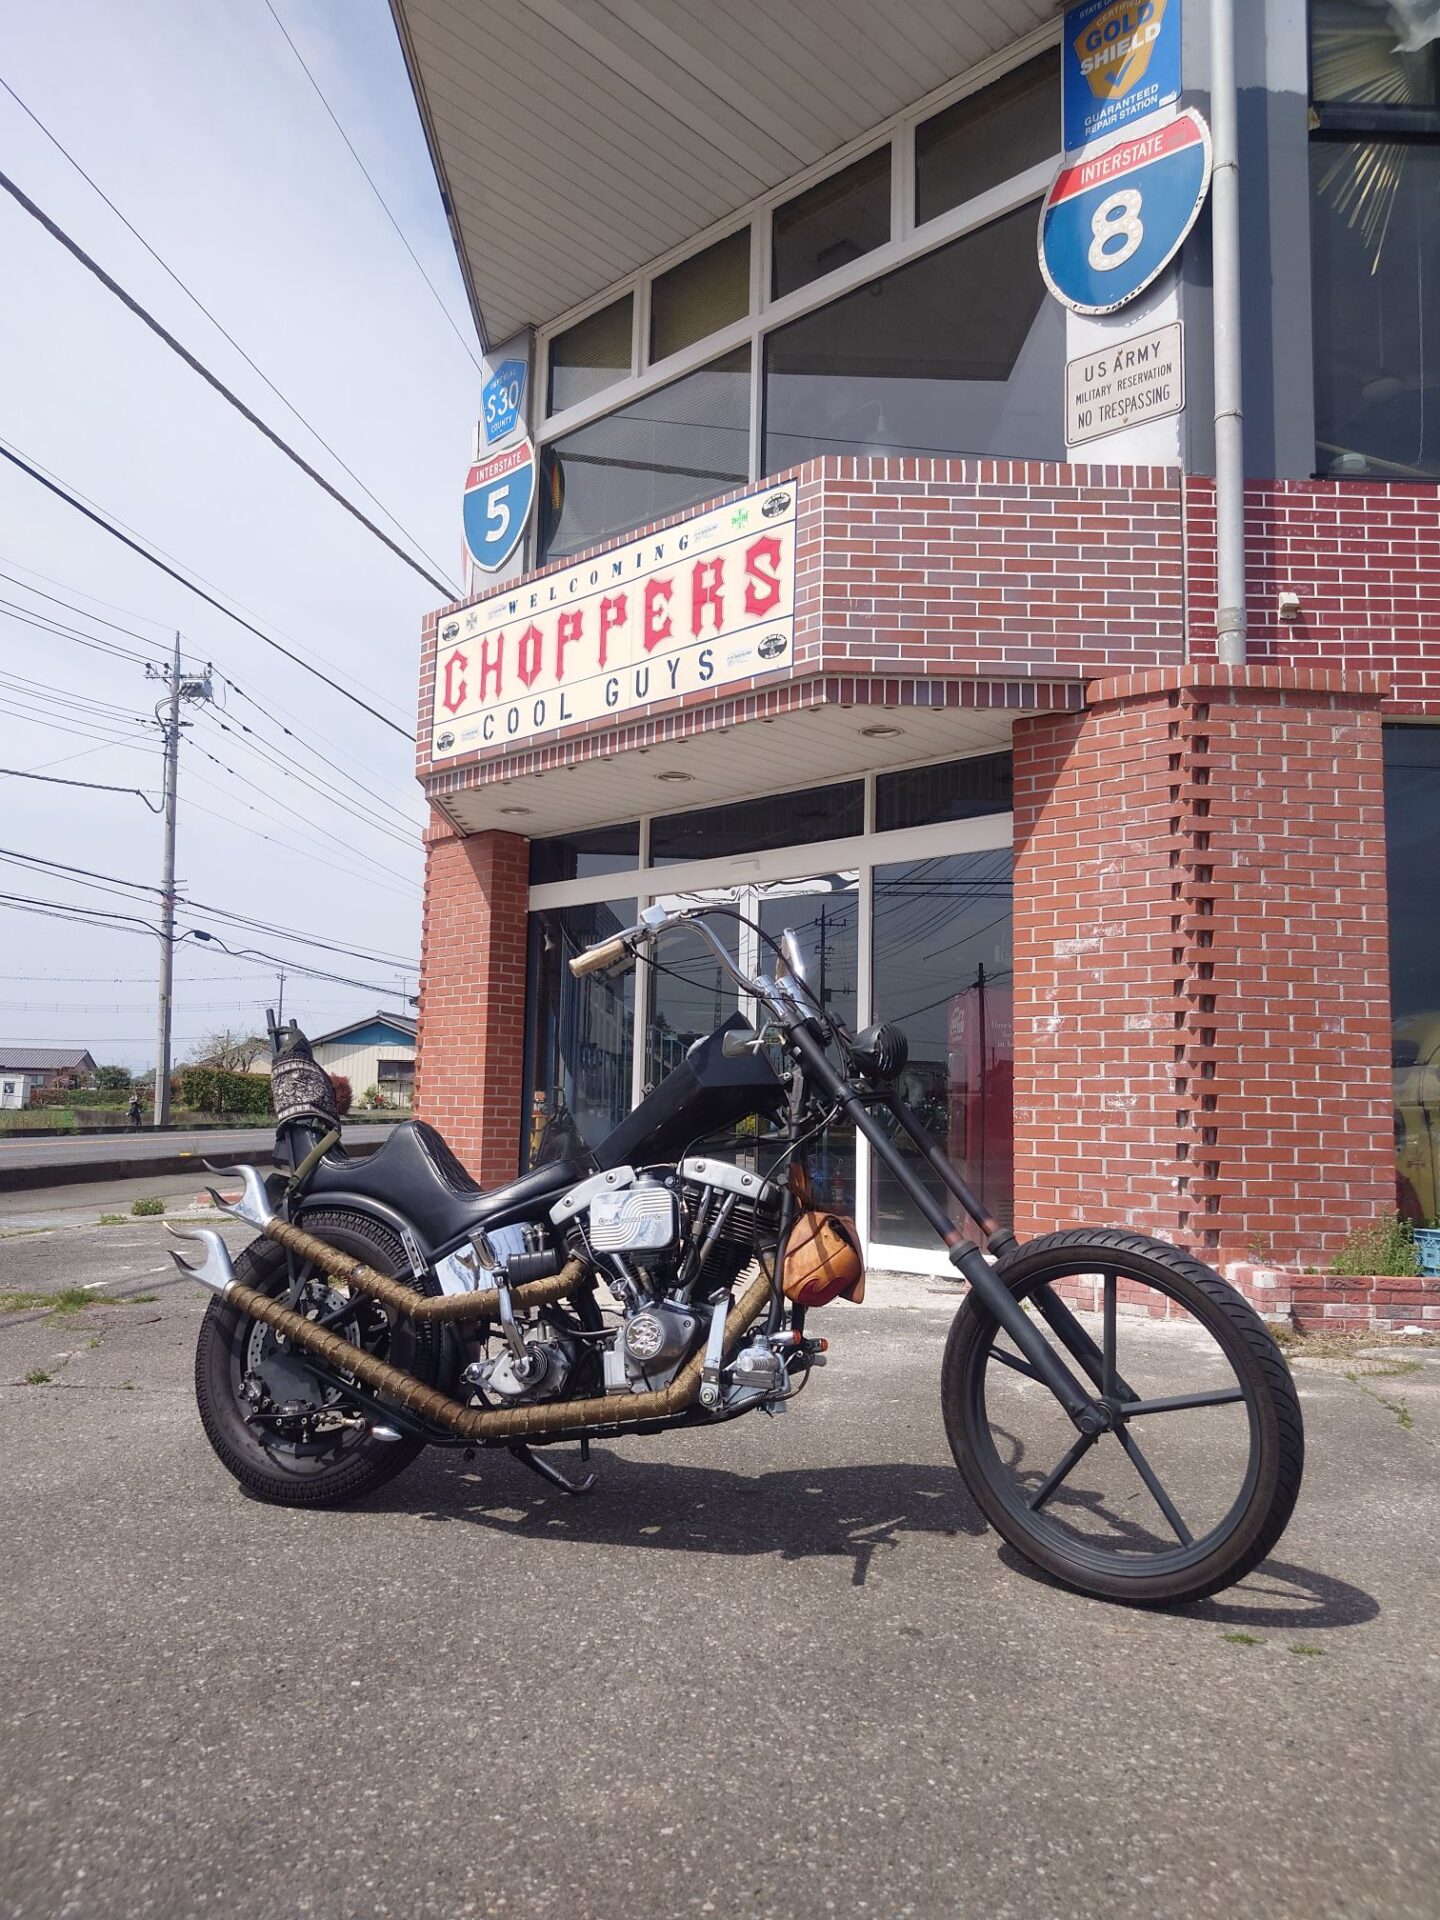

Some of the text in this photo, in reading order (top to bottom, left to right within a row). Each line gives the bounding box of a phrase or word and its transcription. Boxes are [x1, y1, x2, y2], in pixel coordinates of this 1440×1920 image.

[1080, 23, 1161, 76] SHIELD
[1085, 2, 1154, 52] GOLD
[1084, 84, 1159, 127] GUARANTEED
[1085, 94, 1158, 136] REPAIR STATION
[1081, 135, 1164, 184] INTERSTATE
[1088, 189, 1144, 272] 8
[1113, 341, 1161, 373] ARMY
[1075, 362, 1172, 405] MILITARY RESERVATION
[1078, 384, 1170, 429] NO TRESPASSING
[490, 414, 513, 433] COUNTY
[476, 451, 522, 483] INTERSTATE
[485, 484, 510, 542] 5
[508, 534, 689, 615] WELCOMING
[442, 535, 783, 714] CHOPPERS
[483, 649, 714, 741] COOL GUYS
